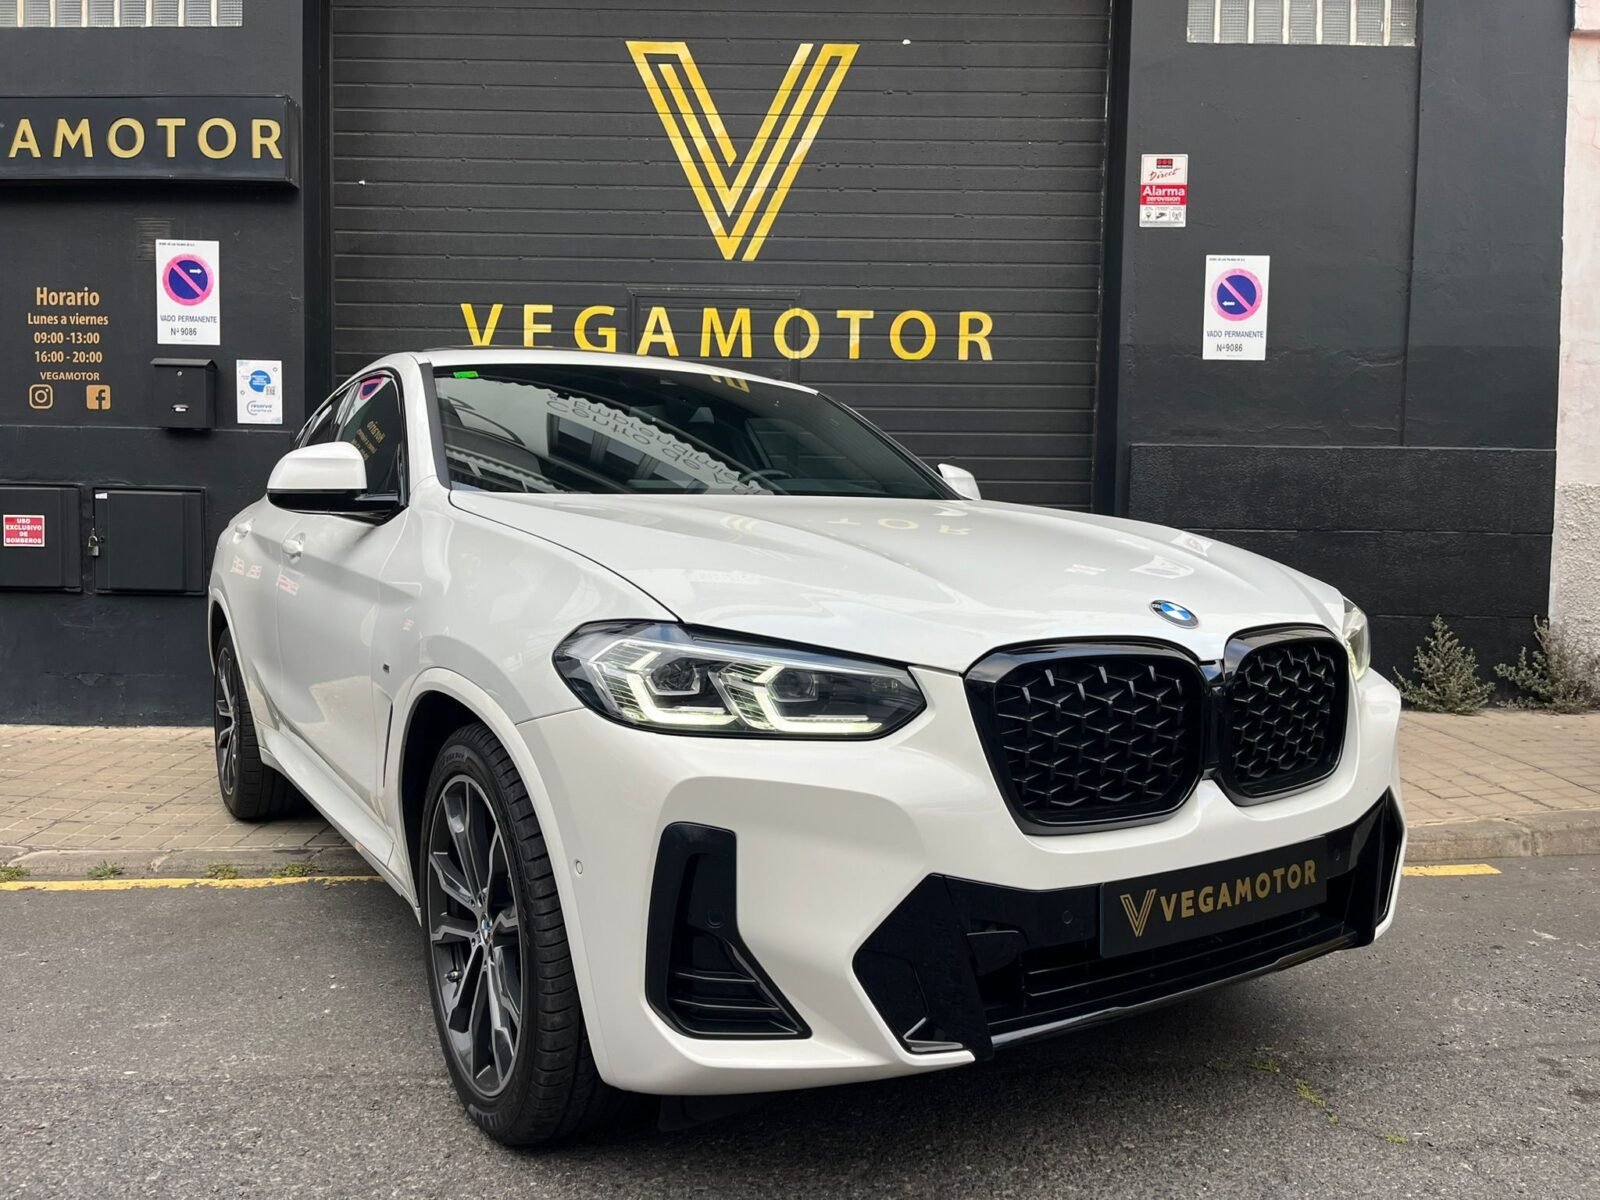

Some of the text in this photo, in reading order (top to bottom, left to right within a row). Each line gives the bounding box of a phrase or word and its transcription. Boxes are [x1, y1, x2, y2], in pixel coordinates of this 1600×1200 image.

[8, 117, 284, 160] AMOTOR
[1142, 185, 1185, 196] Alarma
[36, 286, 100, 306] Horario
[27, 312, 109, 325] Lunes a viernes
[178, 315, 217, 323] PERMANENTE
[33, 332, 64, 344] 09:00
[460, 303, 993, 361] VEGAMOTOR
[1206, 330, 1264, 338] VADO PERMANENTE
[34, 351, 64, 363] 16:00
[72, 351, 103, 363] 20:00
[40, 371, 100, 381] VEGAMOTOR
[1160, 859, 1316, 923] VEGAMOTOR
